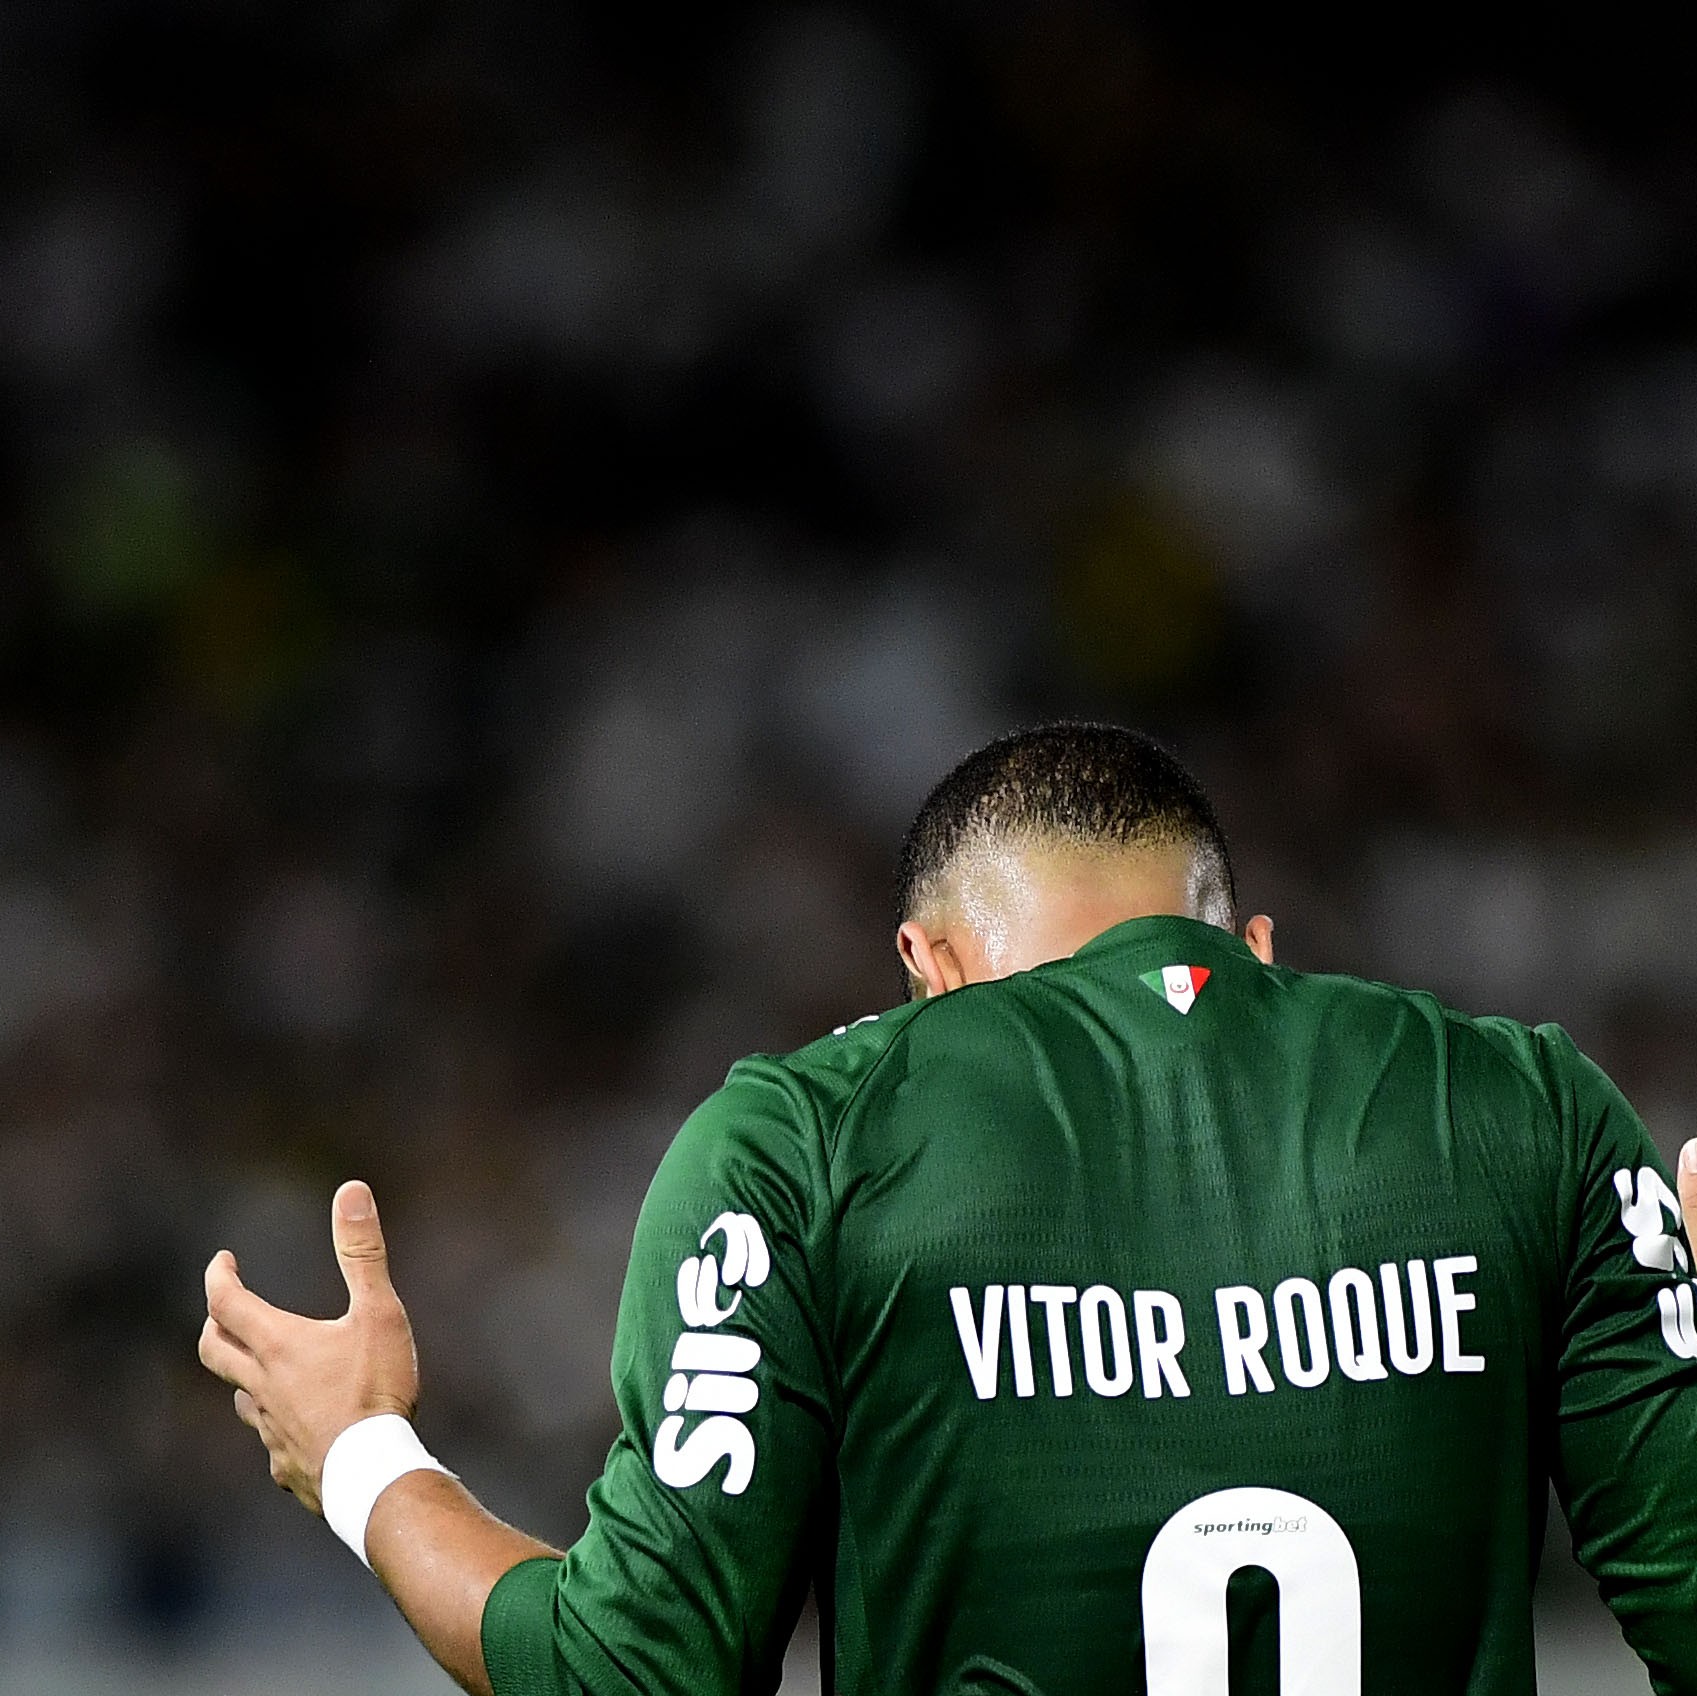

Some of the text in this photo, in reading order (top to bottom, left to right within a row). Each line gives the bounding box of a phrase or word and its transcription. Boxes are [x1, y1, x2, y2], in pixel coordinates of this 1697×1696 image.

[949, 1254, 1486, 1400] VITOR ROQUE
[1193, 1516, 1308, 1537] sportingbet
